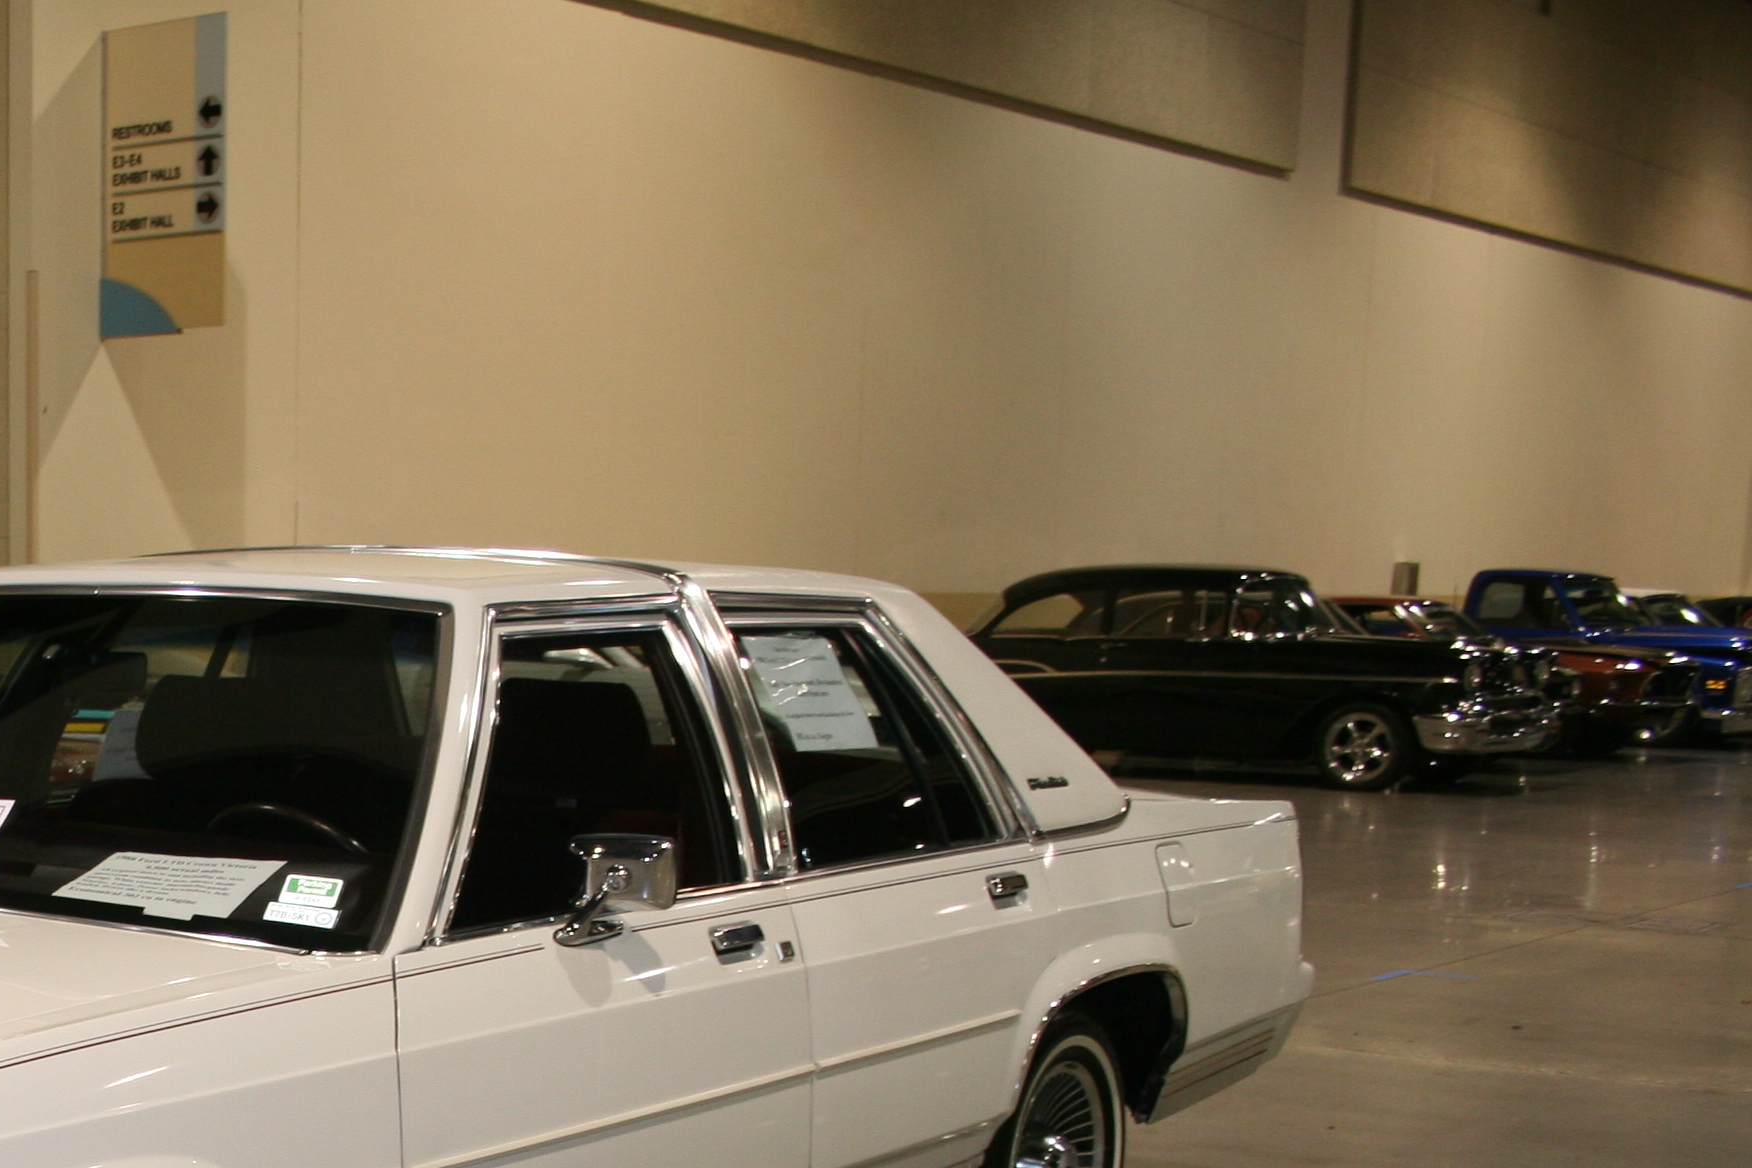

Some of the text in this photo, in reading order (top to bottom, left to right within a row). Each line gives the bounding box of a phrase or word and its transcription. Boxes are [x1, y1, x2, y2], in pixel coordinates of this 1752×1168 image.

[112, 120, 172, 139] RESTROOMS
[112, 154, 142, 169] E3-E4
[112, 166, 181, 186] EXHIBIT HALLS
[112, 202, 124, 215] E2
[112, 214, 174, 233] EXHIBIT HALL
[297, 878, 333, 890] Parking
